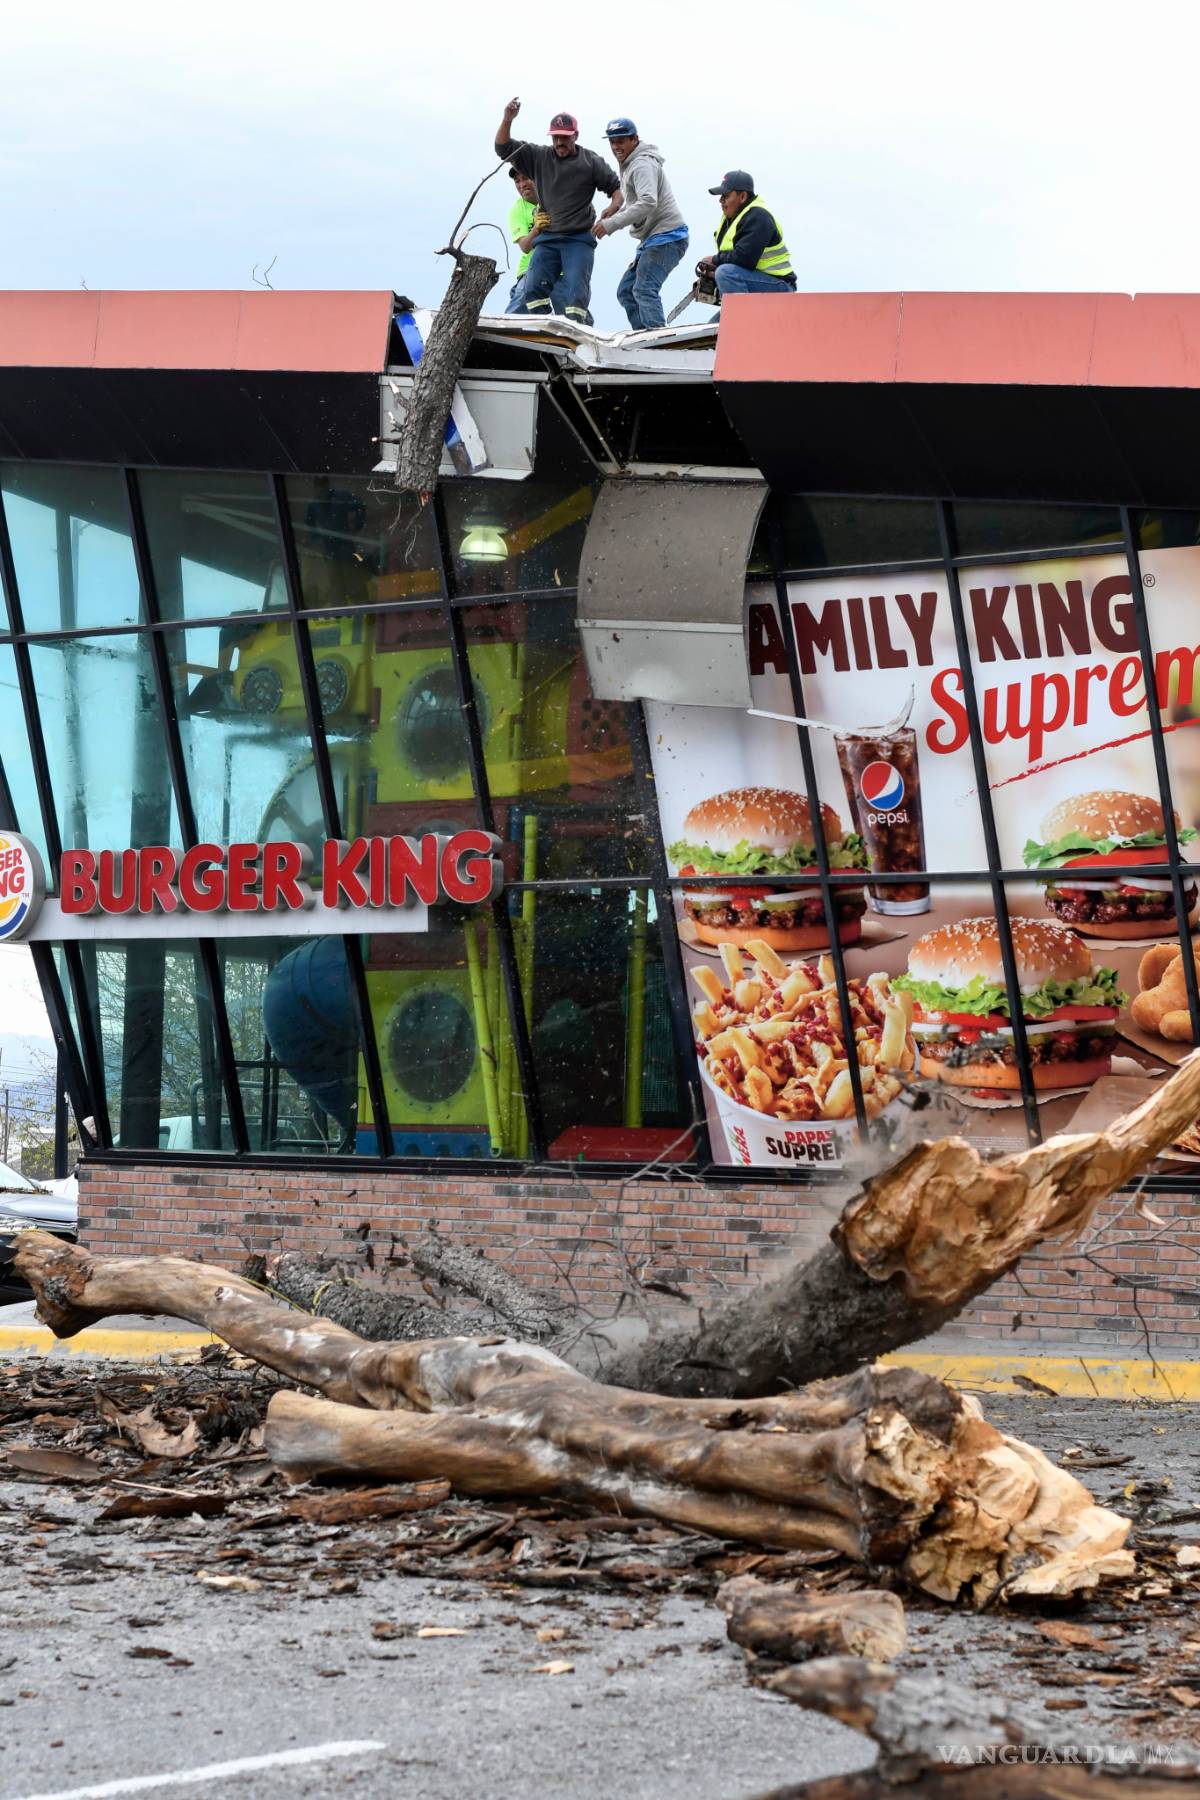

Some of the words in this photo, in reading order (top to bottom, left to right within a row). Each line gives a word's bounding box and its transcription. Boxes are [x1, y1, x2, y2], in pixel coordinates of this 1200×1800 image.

[749, 592, 938, 676] AMILY
[969, 575, 1141, 662] KING
[867, 809, 909, 828] pepsi
[60, 842, 304, 915] BURGER
[322, 829, 493, 909] KING
